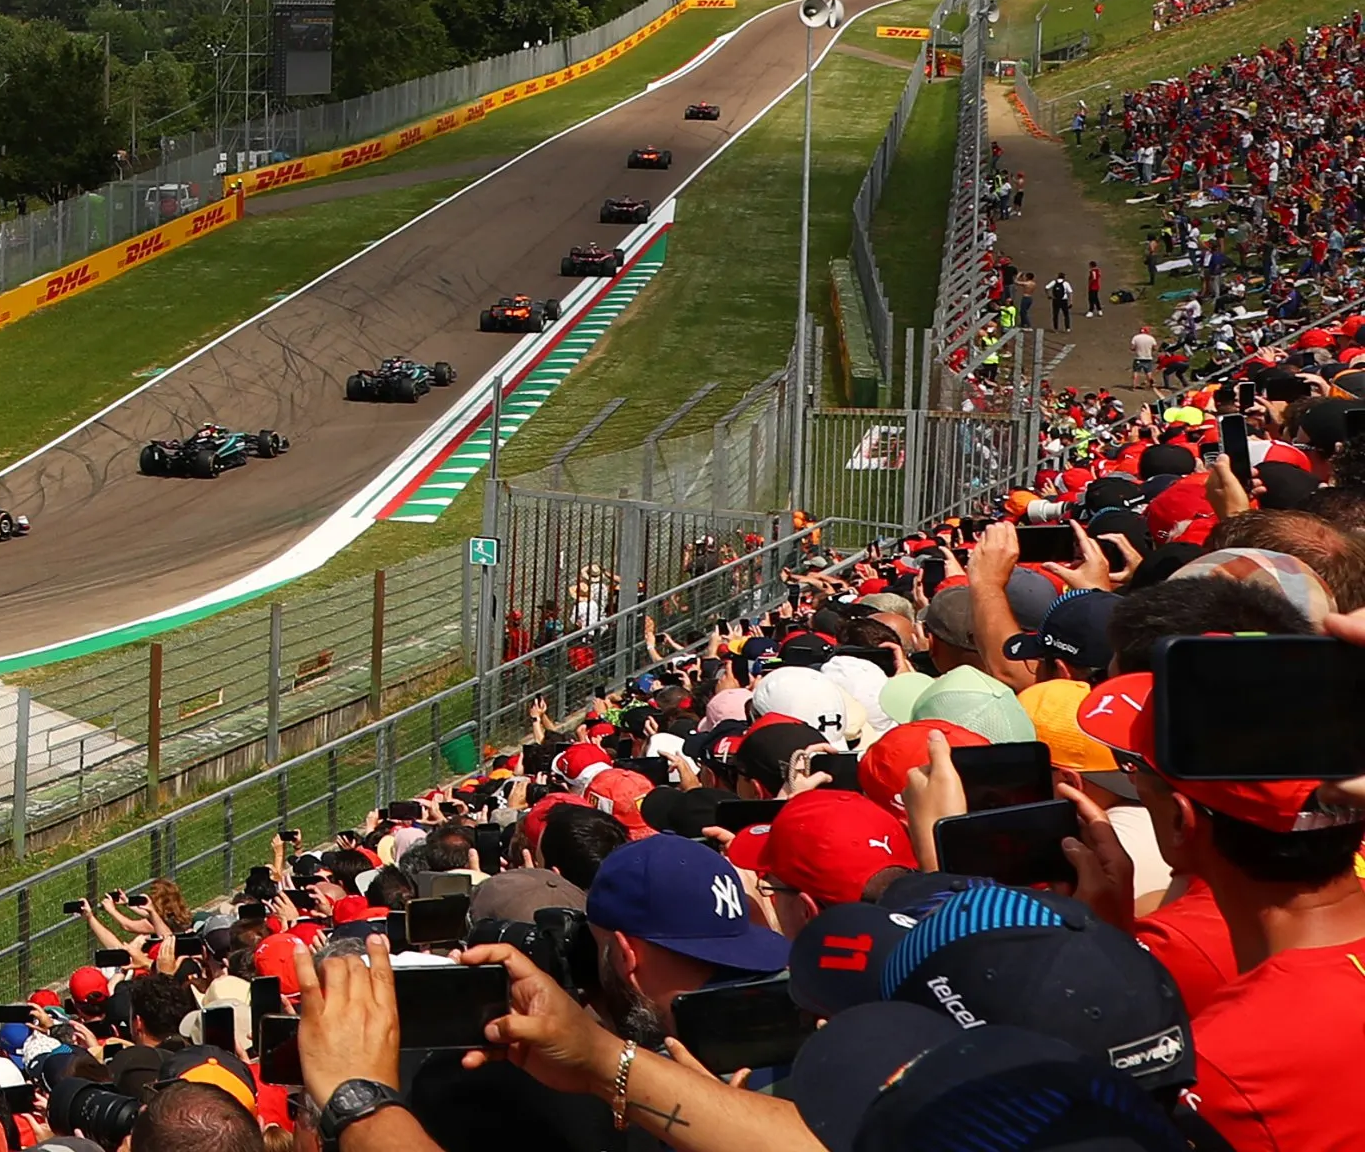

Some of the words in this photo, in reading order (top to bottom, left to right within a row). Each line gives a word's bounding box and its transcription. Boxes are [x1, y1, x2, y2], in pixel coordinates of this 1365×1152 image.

[887, 29, 922, 37] DHL
[400, 127, 424, 148] DHL
[341, 142, 387, 169] DHL
[255, 163, 307, 191] DHL
[192, 205, 225, 235] DHL
[124, 233, 165, 265] DHL
[46, 264, 92, 301] DHL
[1052, 638, 1080, 656] viaplay
[711, 874, 744, 919] NY
[819, 933, 874, 972] 11
[927, 975, 987, 1030] telcel
